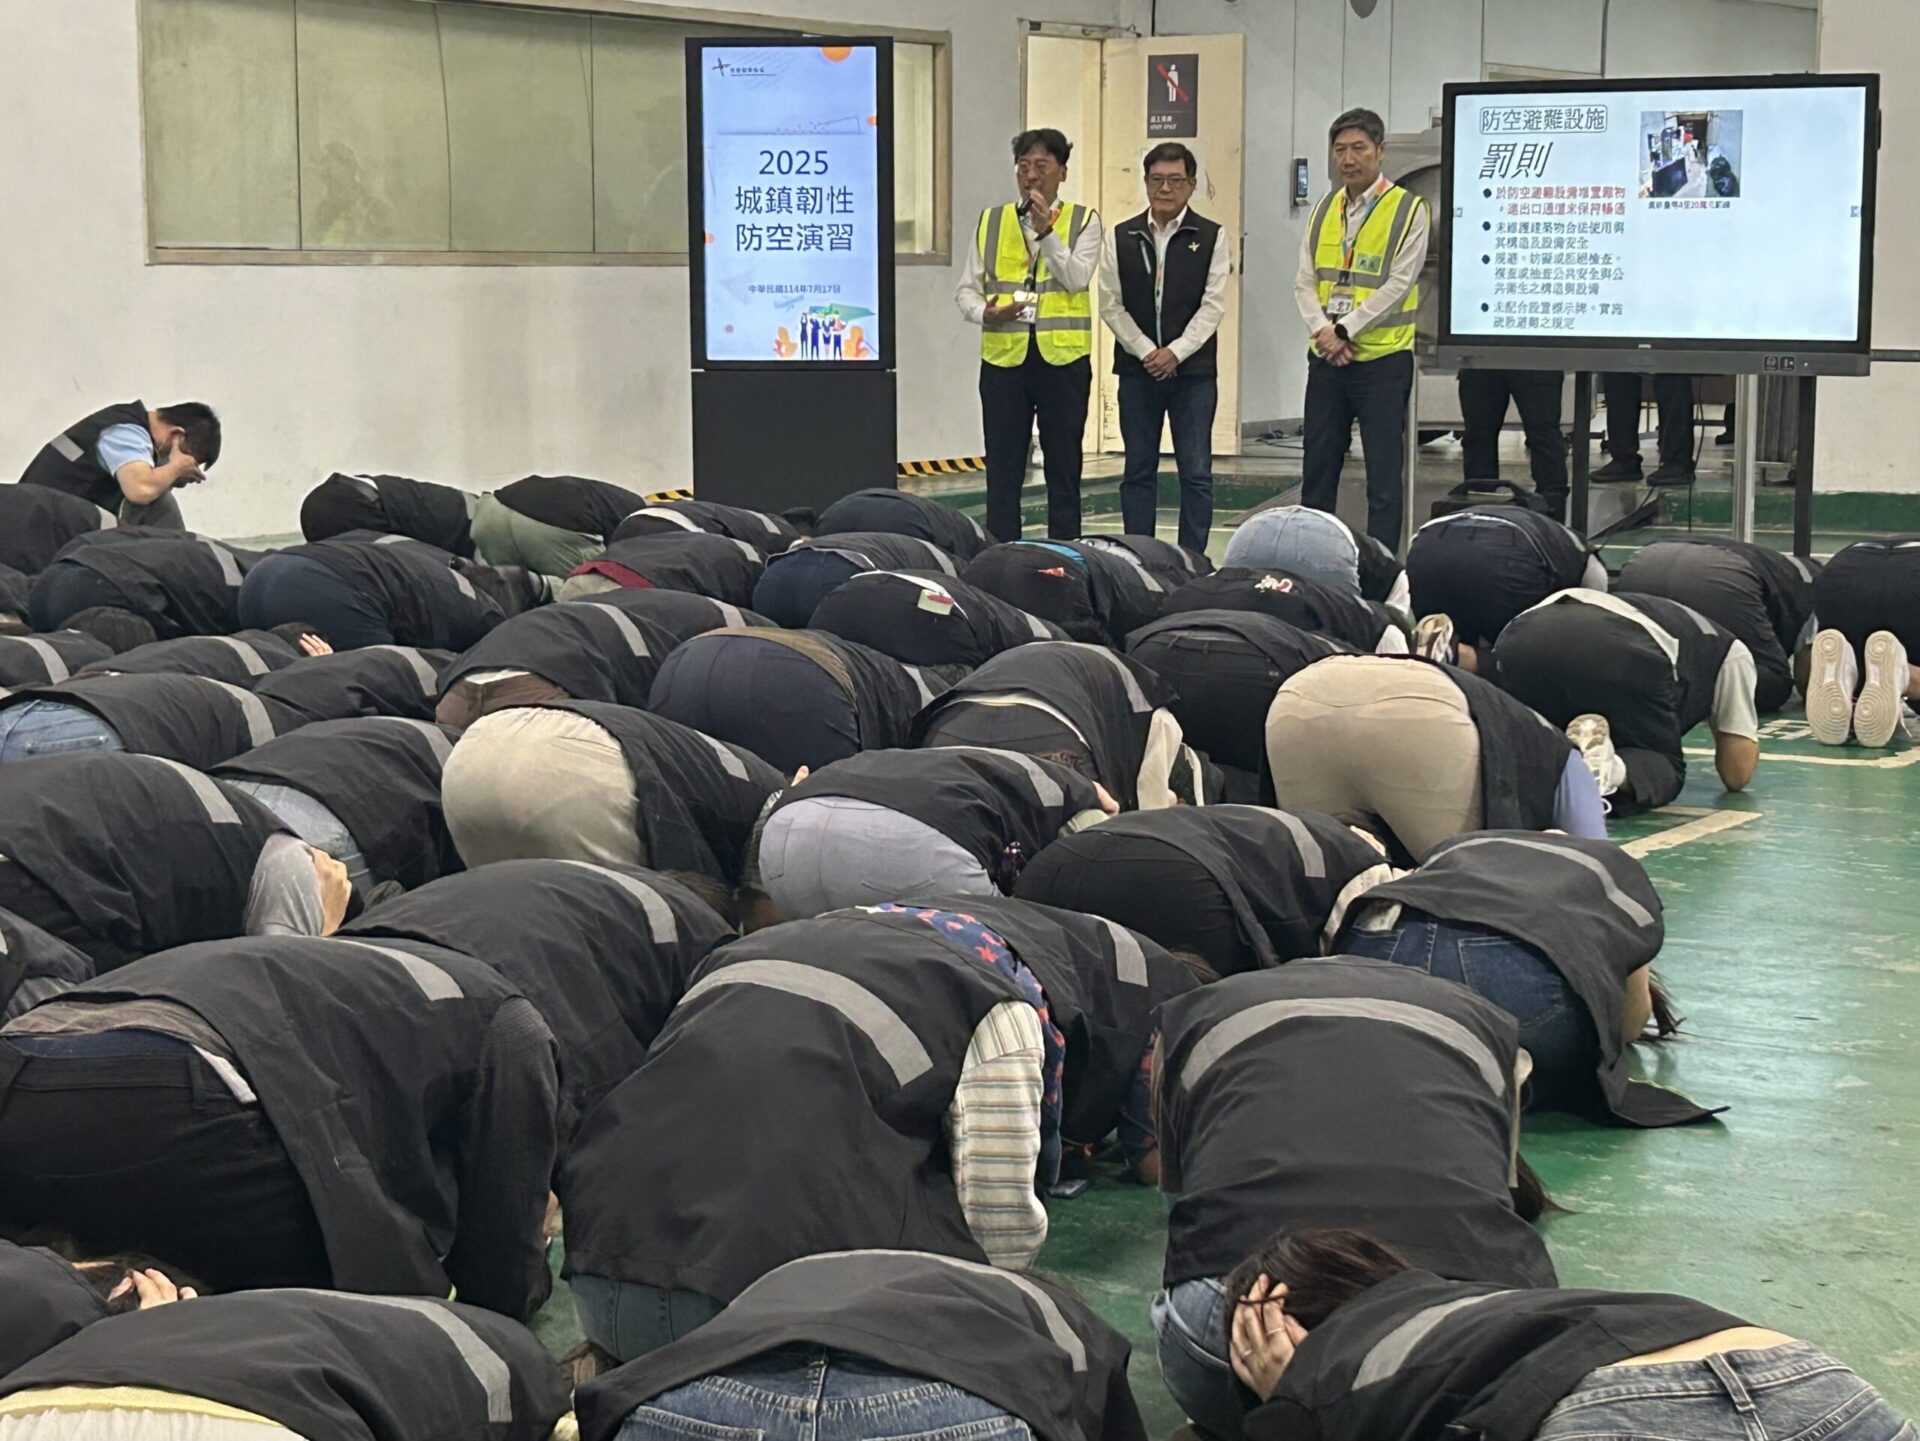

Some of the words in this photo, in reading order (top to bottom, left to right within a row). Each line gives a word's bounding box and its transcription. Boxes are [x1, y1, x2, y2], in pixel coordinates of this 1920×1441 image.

[1481, 107, 1606, 132] 防空避難設施
[759, 150, 829, 175] 2025
[1479, 142, 1553, 179] 罰則
[735, 185, 855, 216] 城鎮韌性
[736, 223, 854, 252] 防空演習
[748, 284, 841, 294] 中華民國114年7月17日
